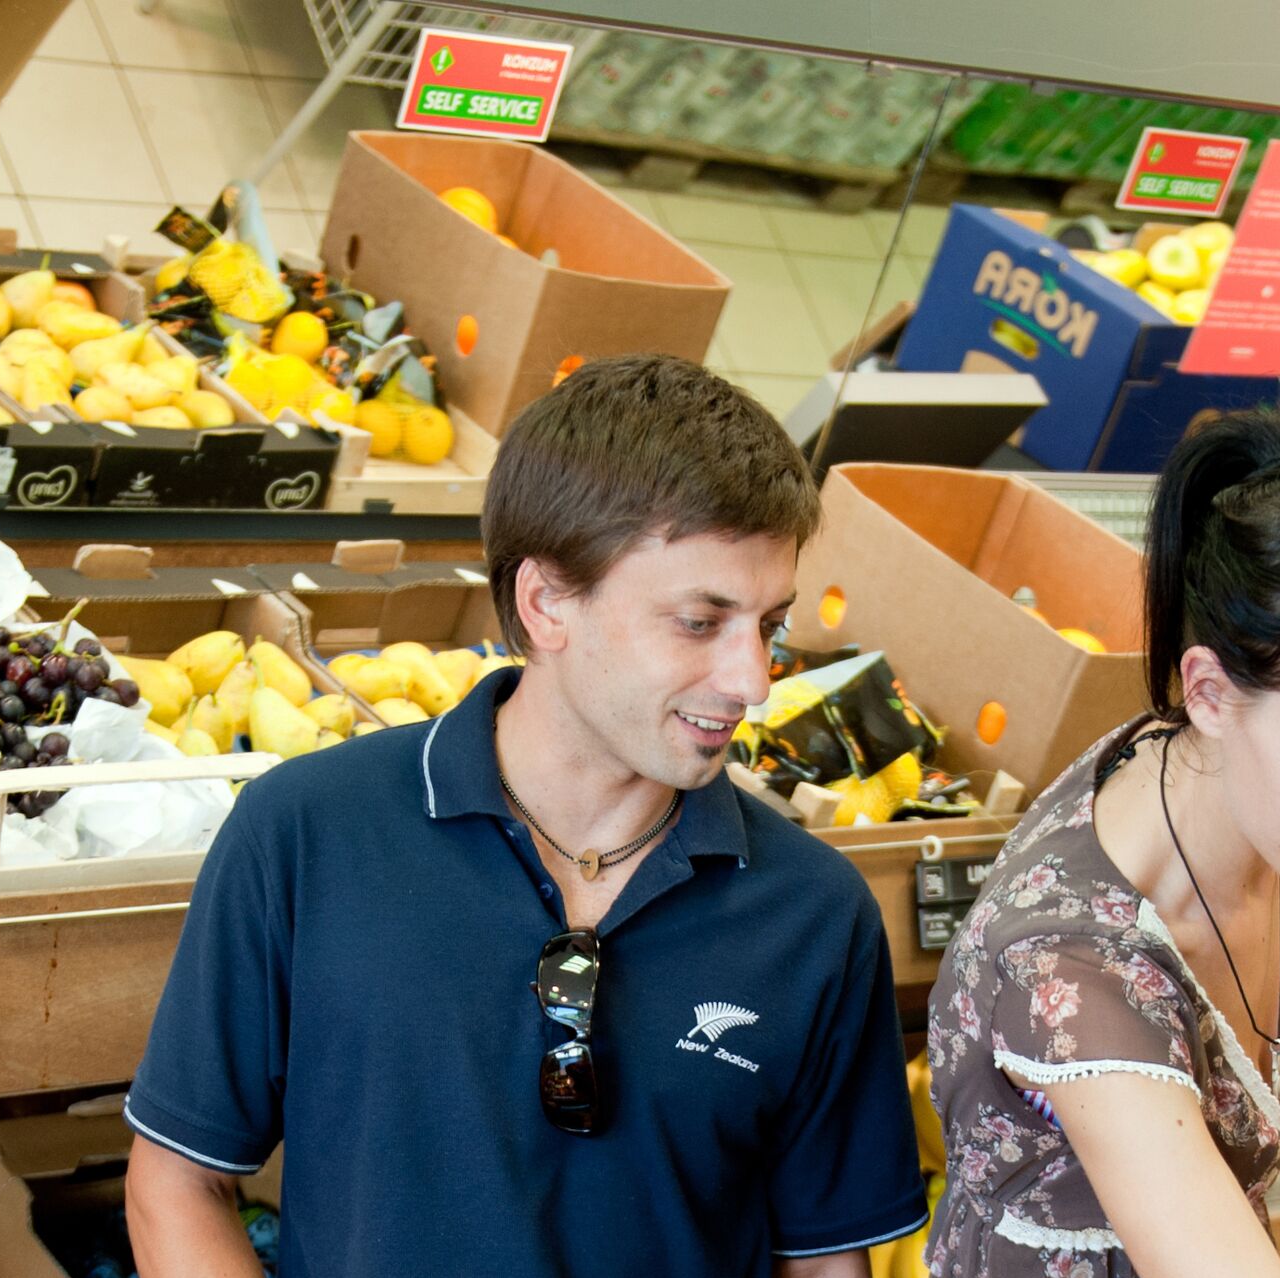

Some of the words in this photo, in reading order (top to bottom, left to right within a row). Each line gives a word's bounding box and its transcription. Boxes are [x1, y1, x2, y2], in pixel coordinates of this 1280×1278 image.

[423, 89, 464, 112] SELF
[467, 94, 539, 121] SERVICE
[1136, 176, 1165, 195] SELF
[1167, 178, 1220, 199] SERVICE
[675, 1038, 710, 1053] New
[713, 1046, 760, 1074] Zealand
